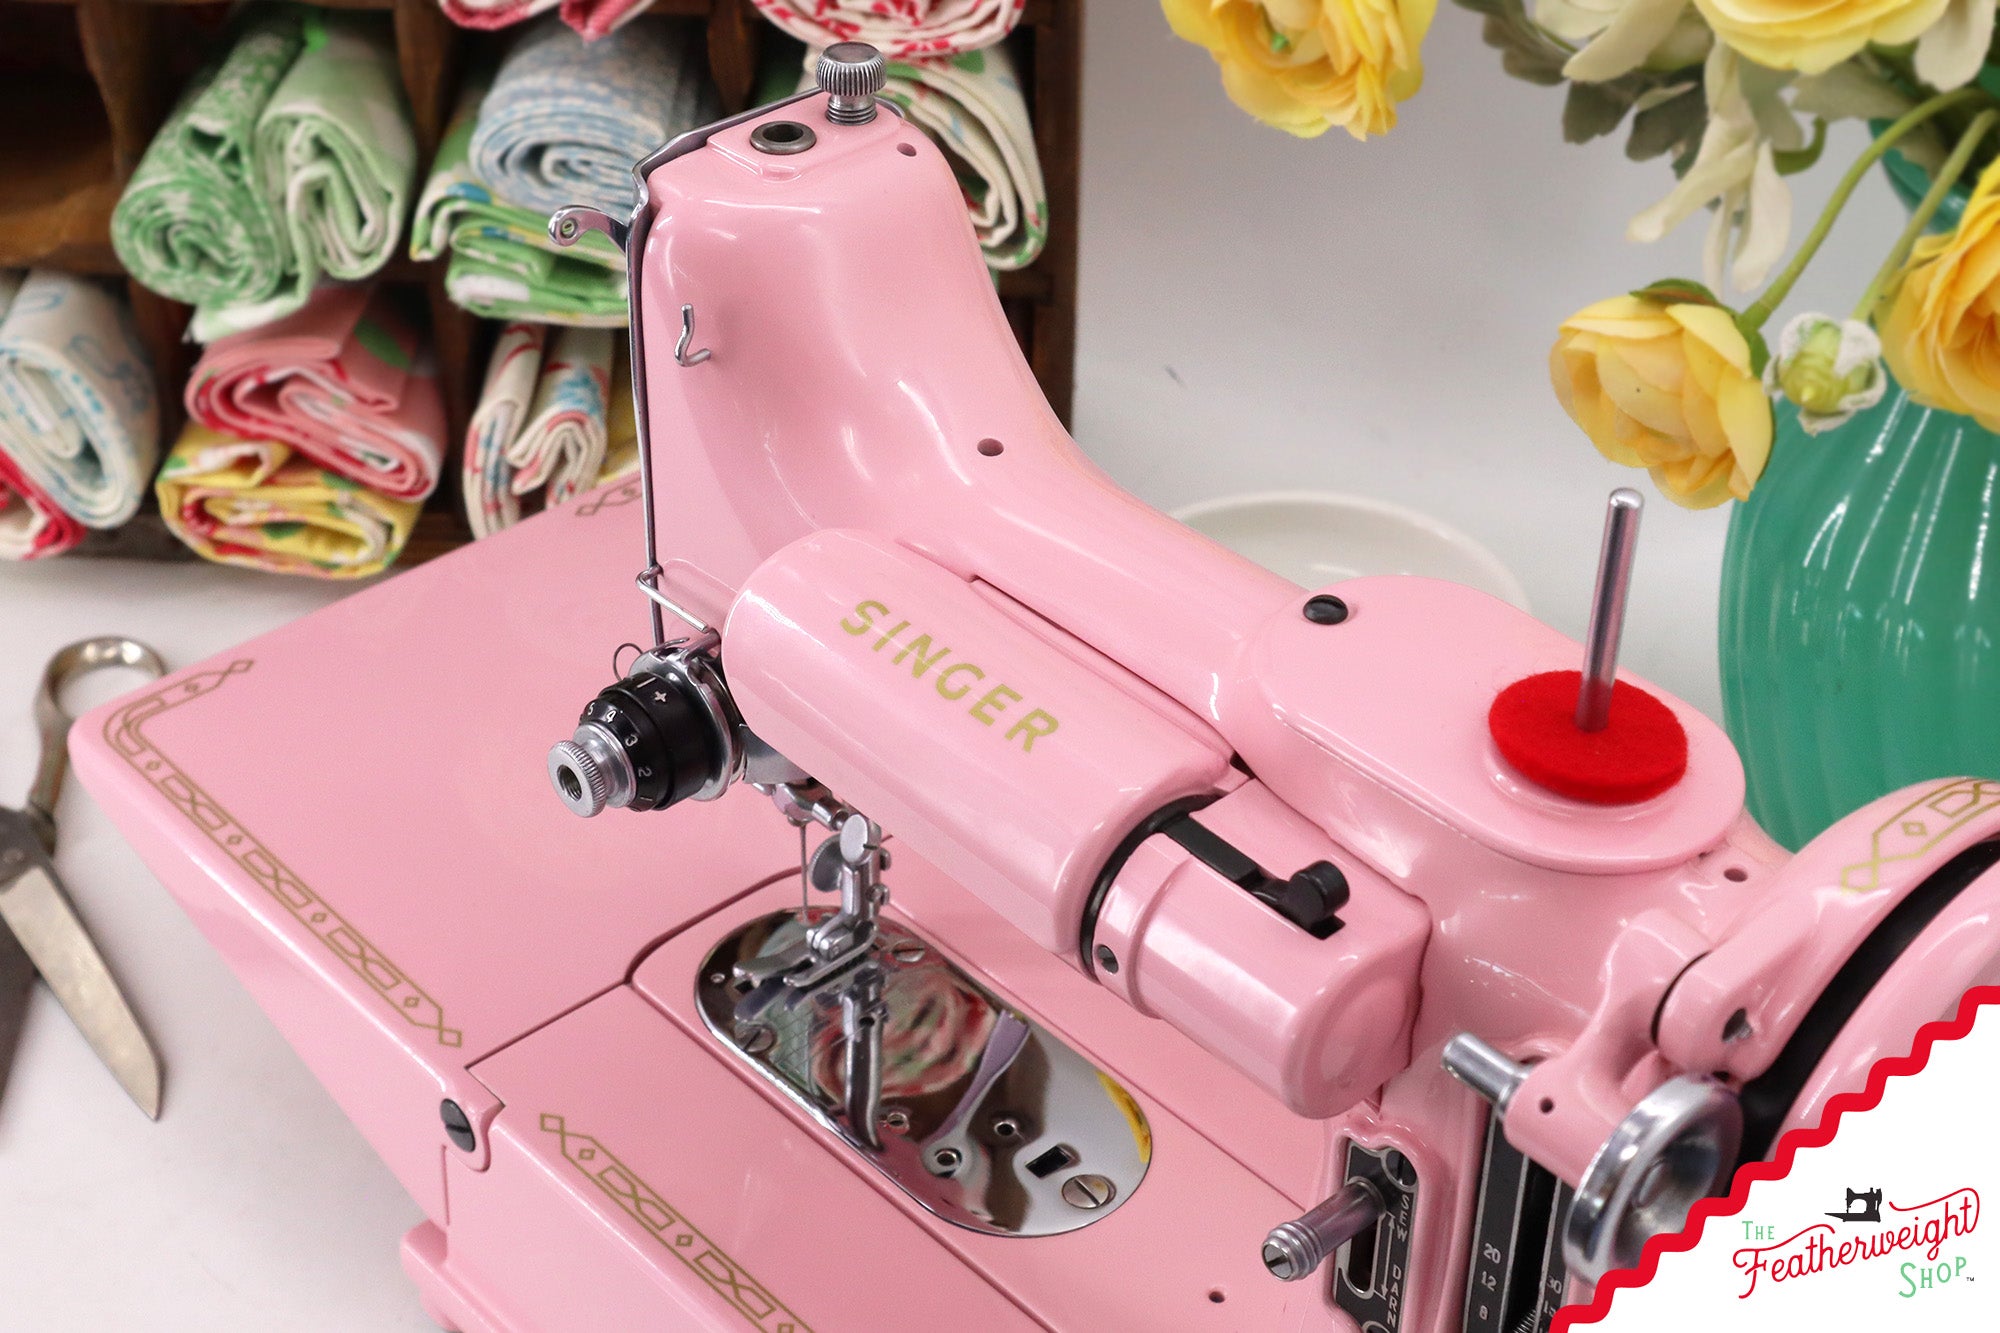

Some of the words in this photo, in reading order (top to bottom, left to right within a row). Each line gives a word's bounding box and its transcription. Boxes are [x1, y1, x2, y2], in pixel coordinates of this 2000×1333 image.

[840, 599, 1059, 753] SINGER
[607, 709, 616, 722] 4
[625, 734, 638, 746] 3
[1397, 1194, 1410, 1243] SEW
[1483, 1243, 1502, 1264] 20
[1387, 1264, 1402, 1328] DARN
[1481, 1271, 1497, 1292] 12
[1479, 1305, 1488, 1320] 8
